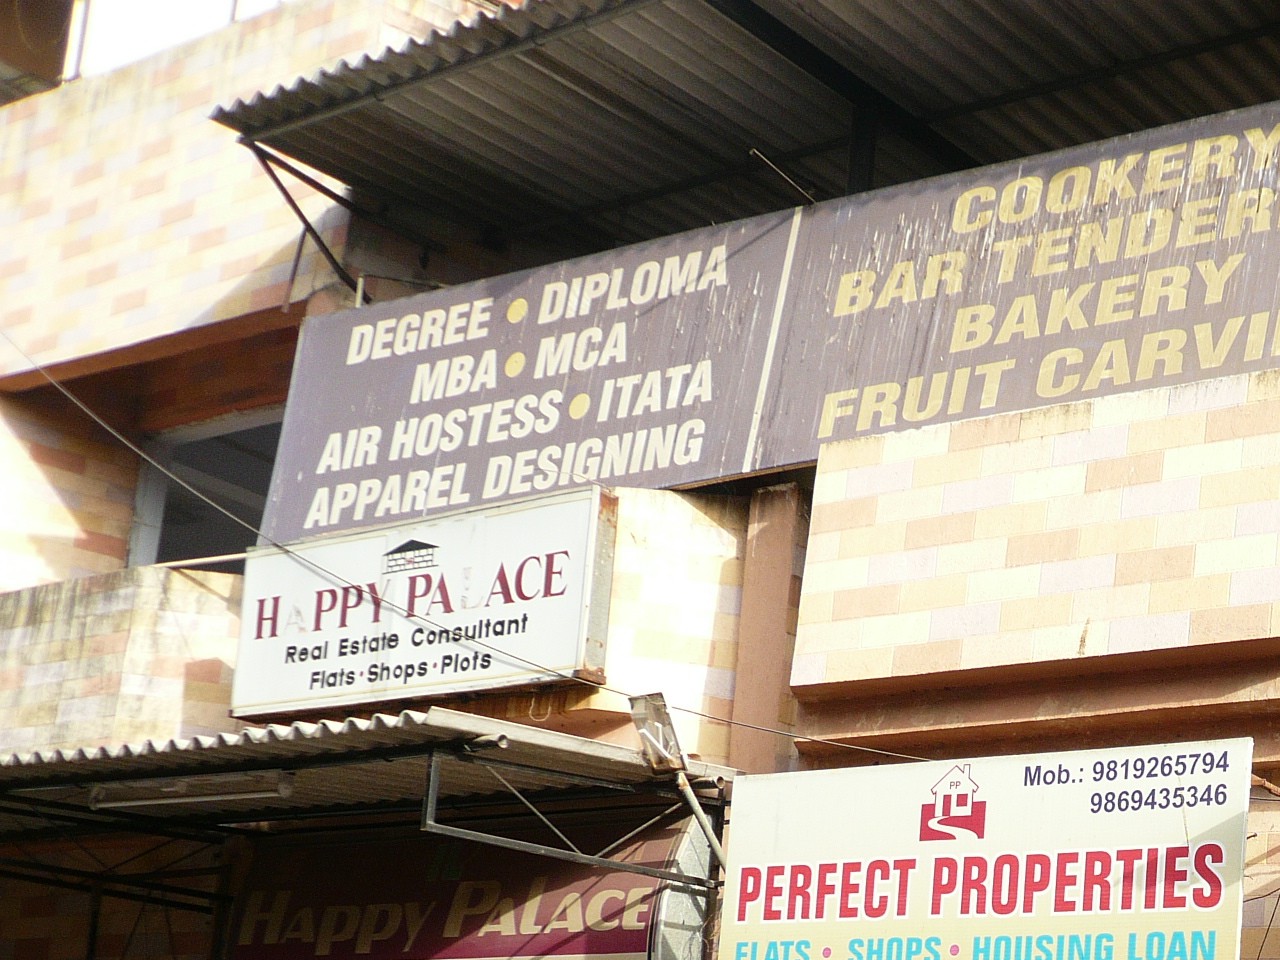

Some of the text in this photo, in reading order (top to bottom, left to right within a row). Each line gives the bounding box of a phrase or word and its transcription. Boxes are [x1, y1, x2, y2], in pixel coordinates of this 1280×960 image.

[347, 246, 727, 364] DEGREE DIPLOMA
[834, 251, 967, 317] BAR
[949, 253, 1246, 353] BAKERY
[410, 323, 626, 403] MBA MCA
[817, 359, 1019, 438] FRUIT
[316, 360, 712, 474] AIR HOSTESS ITATA
[304, 420, 706, 528] APPAREL DESIGNING
[285, 614, 528, 664] Real Estate Consultant
[310, 653, 492, 690] Flats Shops Plots
[949, 780, 962, 790] PP
[1090, 784, 1227, 813] 9869435346
[1092, 751, 1229, 782] 9819265794
[737, 843, 1224, 923] PERFECT PROPERTIES
